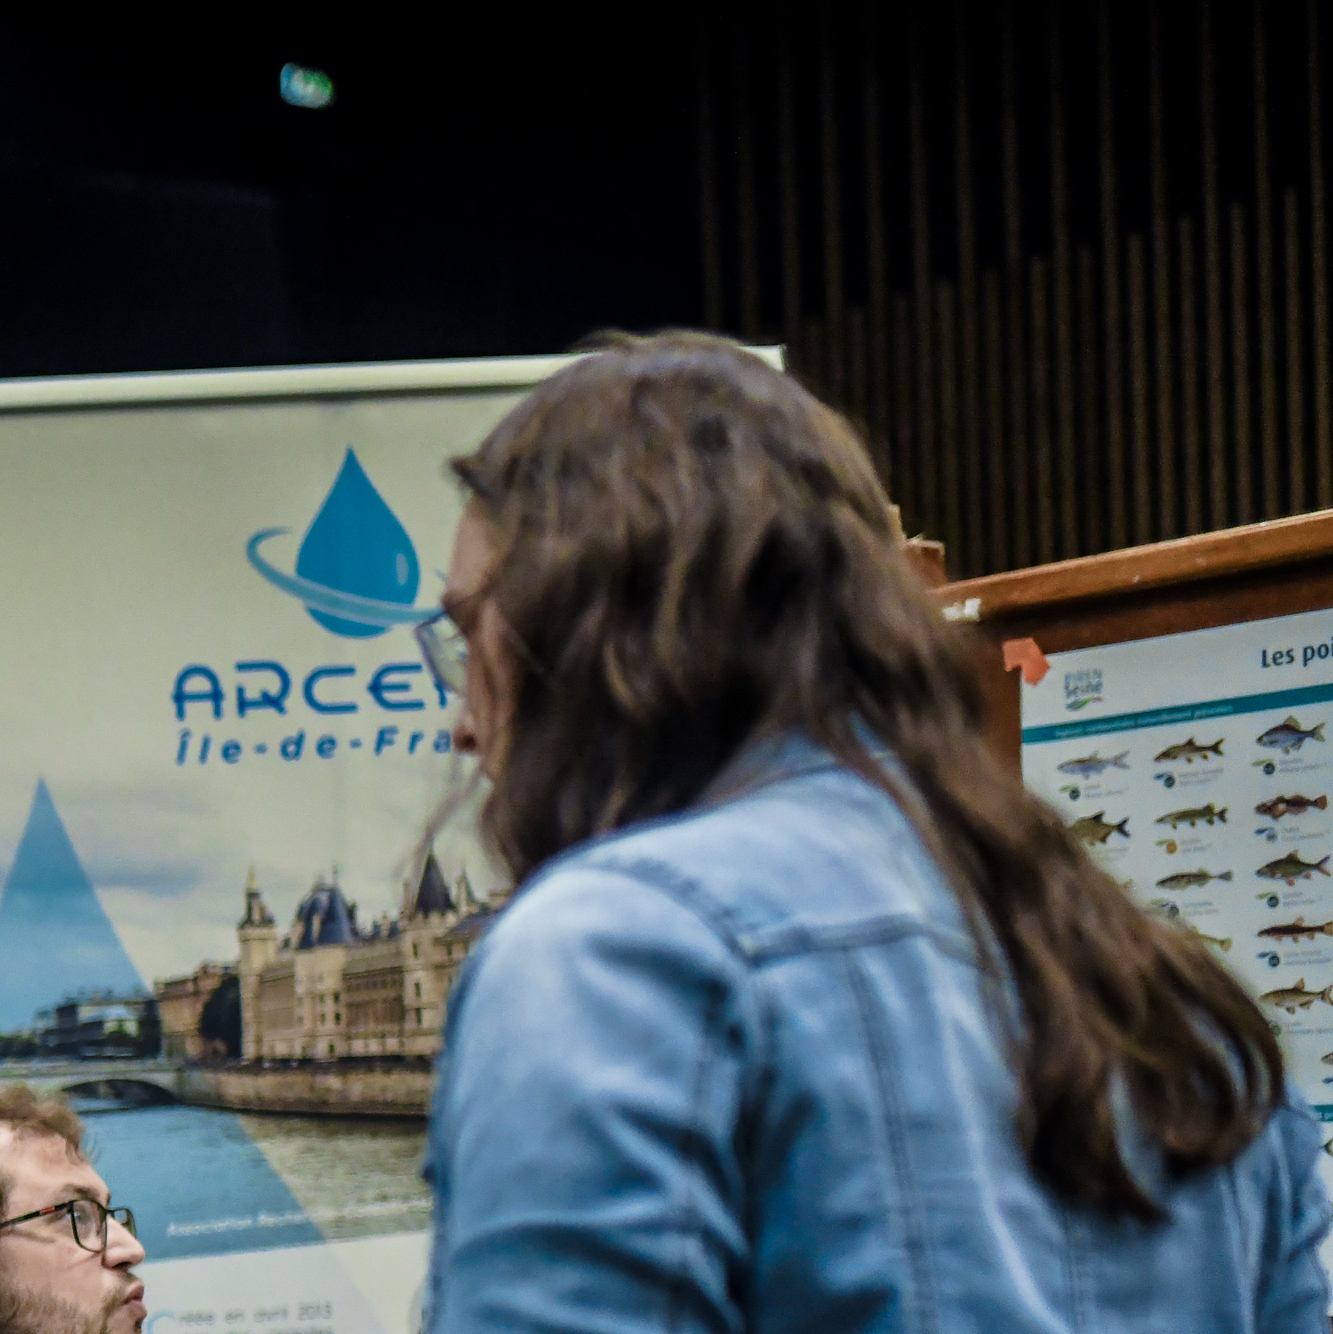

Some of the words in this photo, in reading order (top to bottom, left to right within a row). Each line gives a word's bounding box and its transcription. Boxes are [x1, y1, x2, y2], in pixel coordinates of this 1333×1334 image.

[1261, 648, 1295, 669] Les
[172, 661, 447, 720] ARCE
[175, 725, 452, 766] Île-de-Fra
